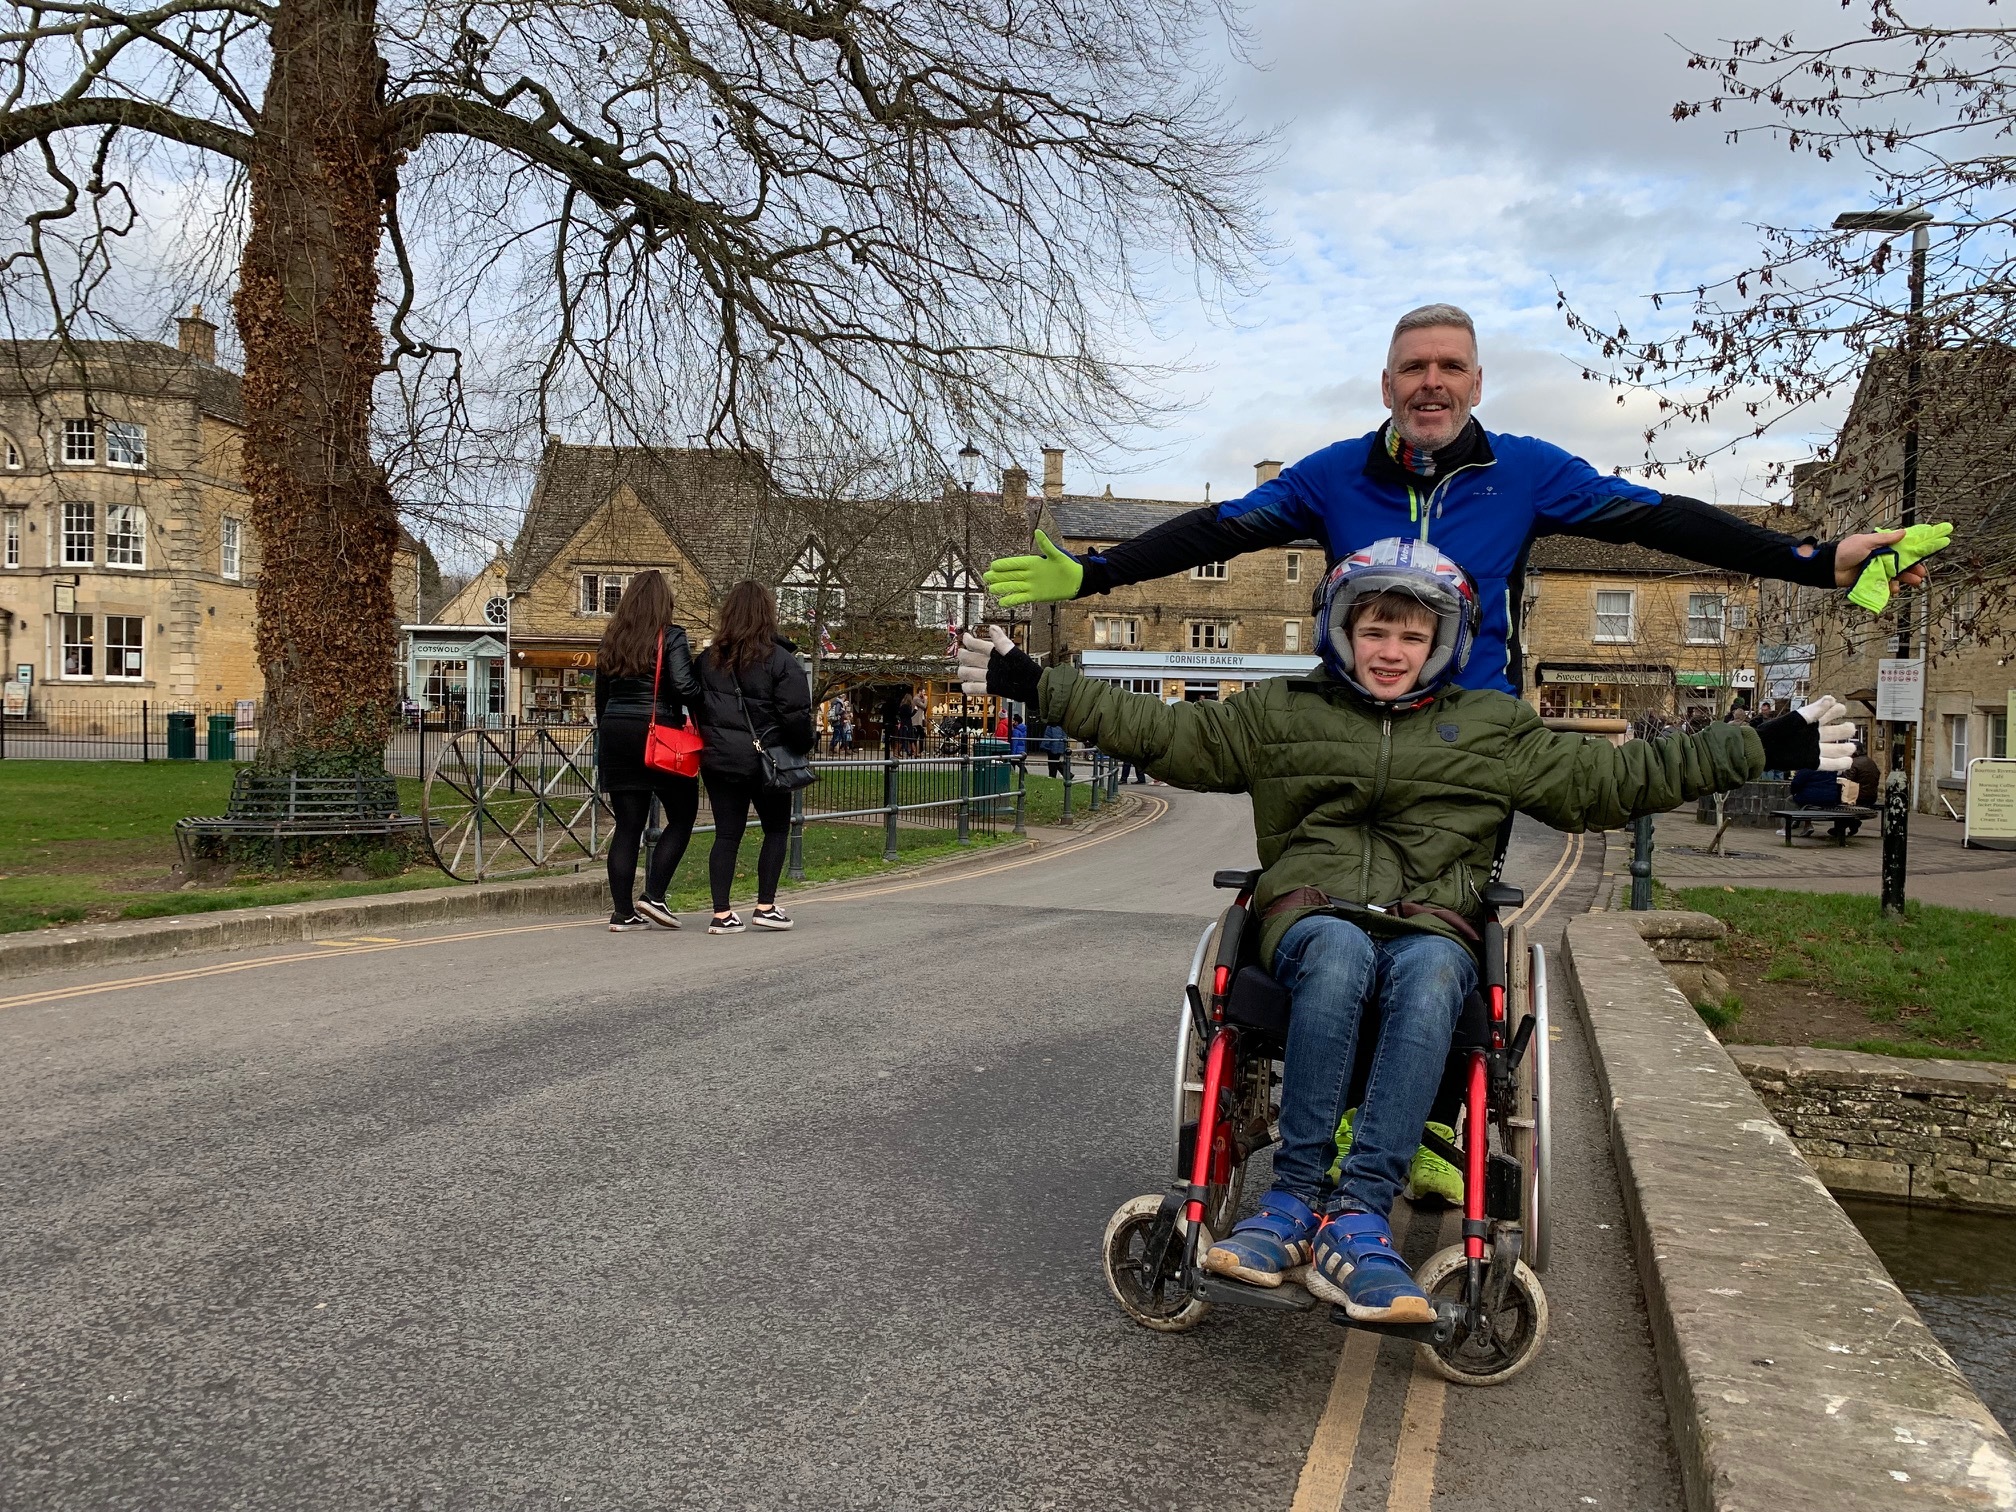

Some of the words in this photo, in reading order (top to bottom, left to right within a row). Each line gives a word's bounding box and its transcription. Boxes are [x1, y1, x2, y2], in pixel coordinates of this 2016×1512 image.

[417, 645, 460, 653] COTSWOLD
[1170, 655, 1207, 664] CORNISH
[1210, 656, 1243, 665] BAKERY
[1556, 672, 1586, 681] Sweet
[1588, 673, 1617, 683] Treats
